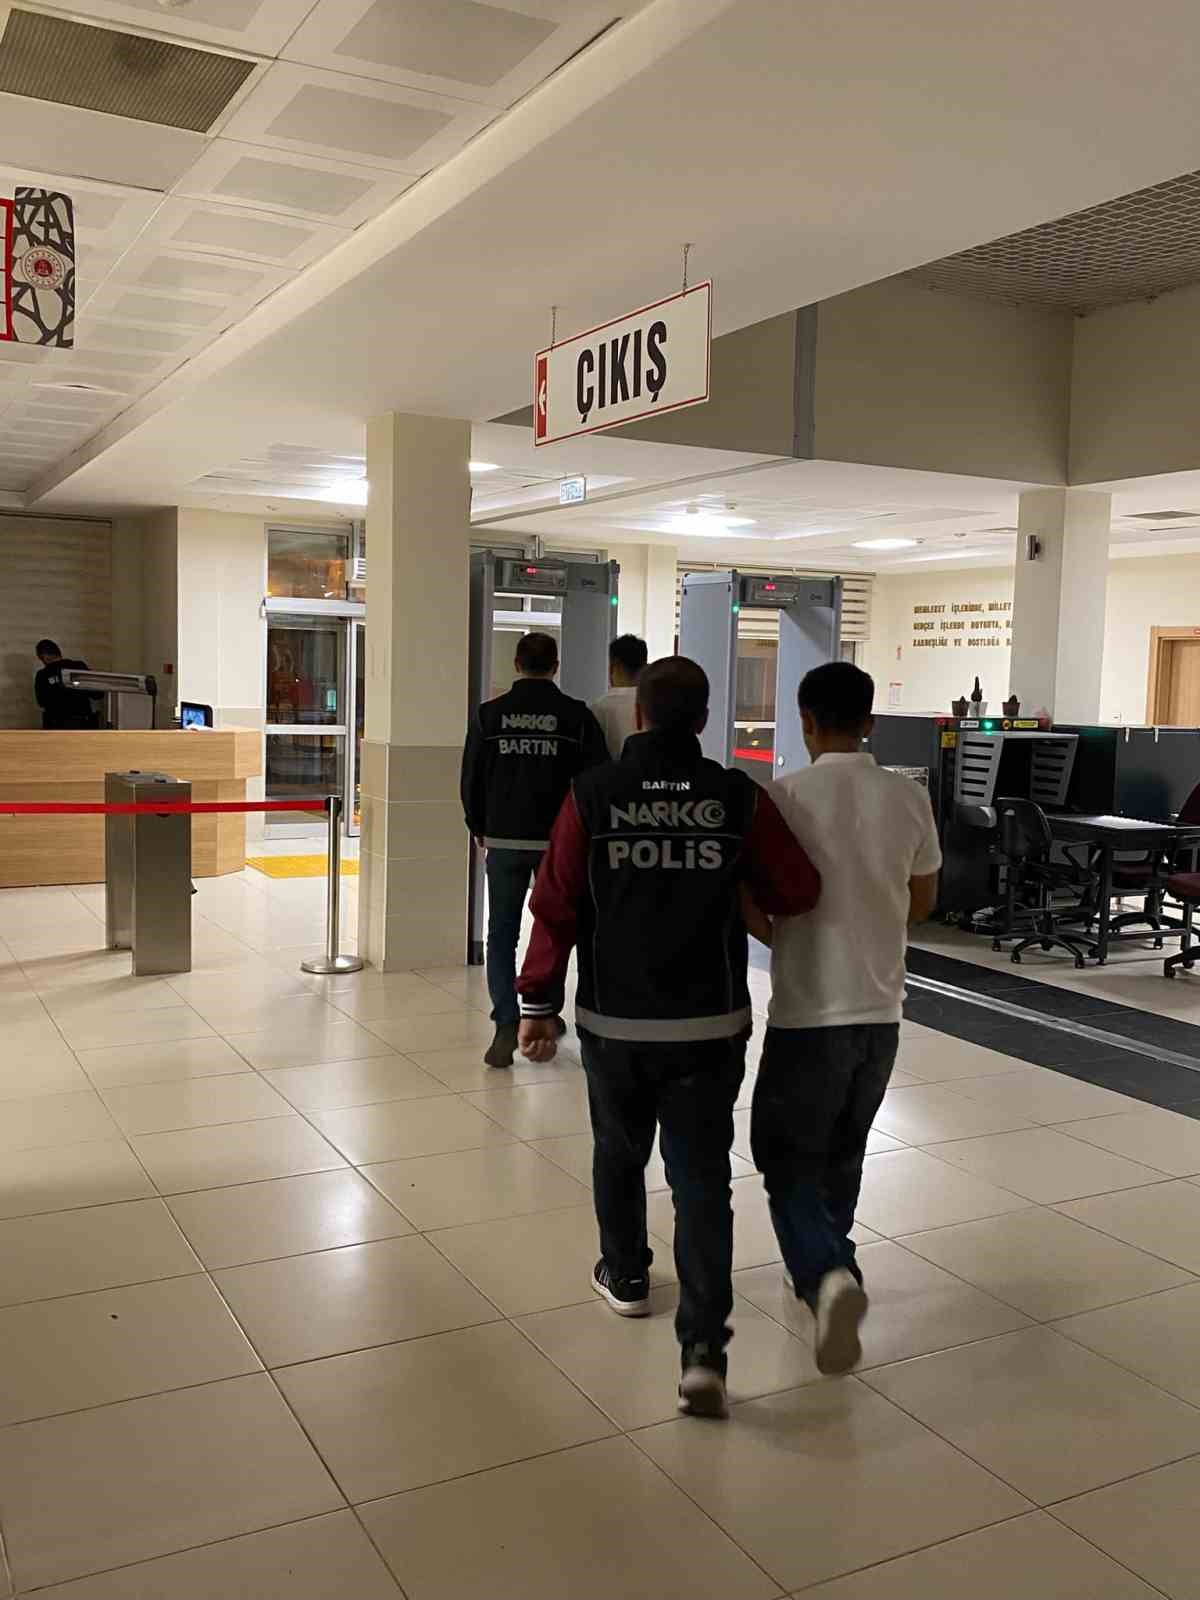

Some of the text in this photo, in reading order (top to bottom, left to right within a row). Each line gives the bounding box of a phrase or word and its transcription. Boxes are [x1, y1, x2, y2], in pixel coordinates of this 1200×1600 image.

[576, 320, 667, 424] ÇIKIŞ
[498, 739, 558, 756] BARTIN
[642, 780, 691, 791] BARTIN
